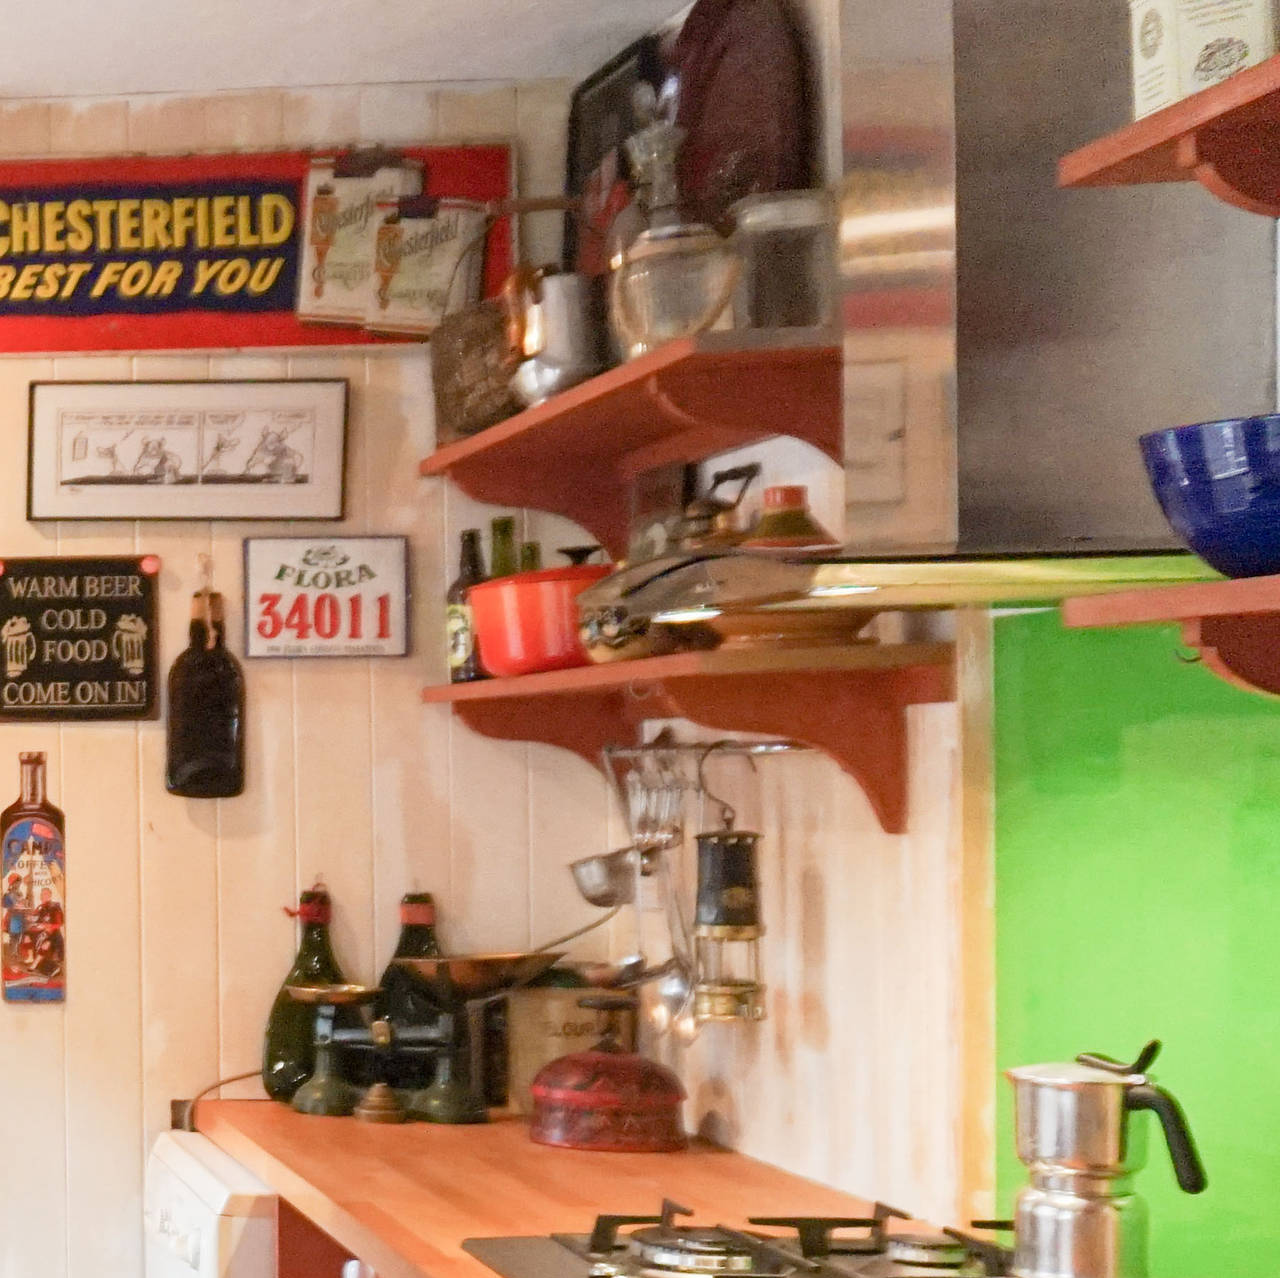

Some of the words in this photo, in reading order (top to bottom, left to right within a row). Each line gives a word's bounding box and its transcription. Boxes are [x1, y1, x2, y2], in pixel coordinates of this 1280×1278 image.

[91, 259, 184, 299] FOR
[193, 256, 287, 296] YOU
[7, 576, 79, 599] WARM
[84, 575, 145, 598] BEER
[274, 563, 378, 590] FLORA
[41, 608, 108, 631] COLD
[256, 593, 392, 640] 34011
[43, 639, 109, 663] FOOD
[3, 682, 71, 704] COME
[76, 681, 110, 704] ON
[115, 681, 148, 704] IN!
